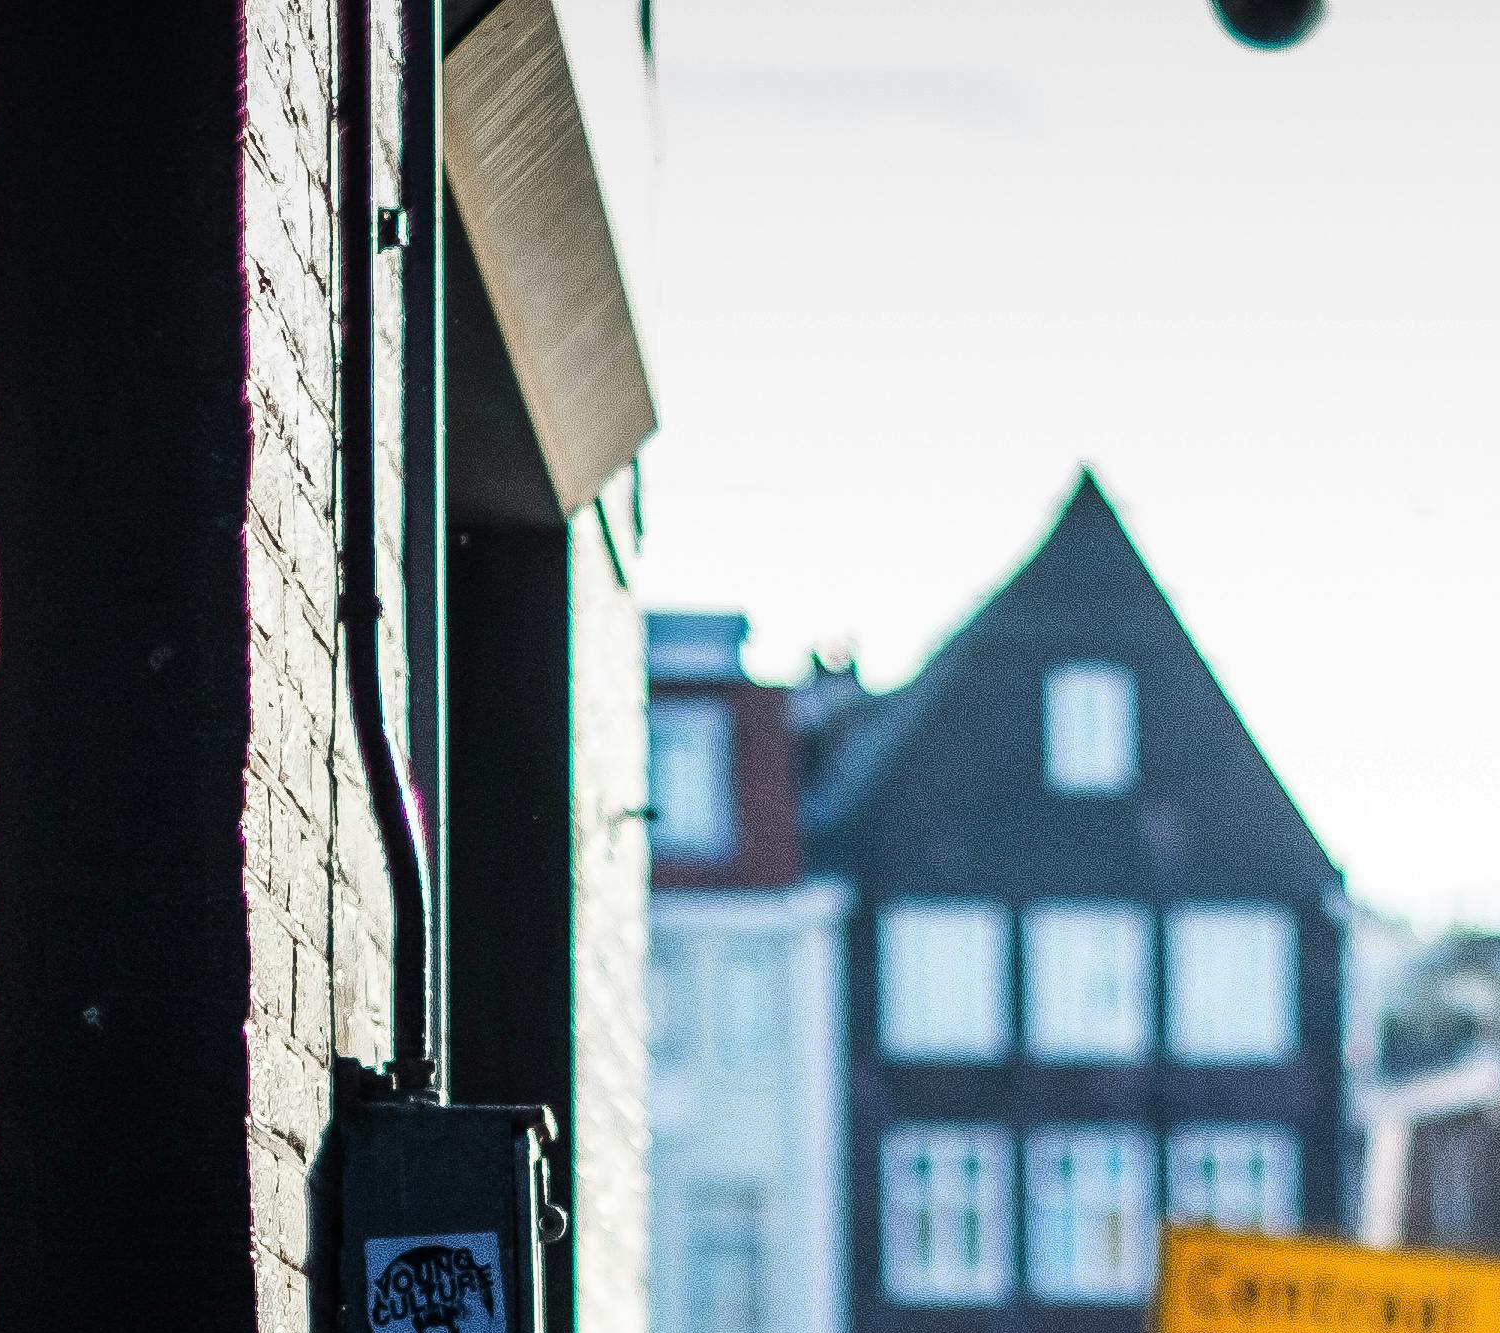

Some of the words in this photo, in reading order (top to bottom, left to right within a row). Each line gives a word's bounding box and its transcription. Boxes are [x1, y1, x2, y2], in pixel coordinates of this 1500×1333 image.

[373, 1263, 495, 1327] CULTURE
[374, 1247, 473, 1299] YOUNG
[1186, 1255, 1476, 1333] Centraal
